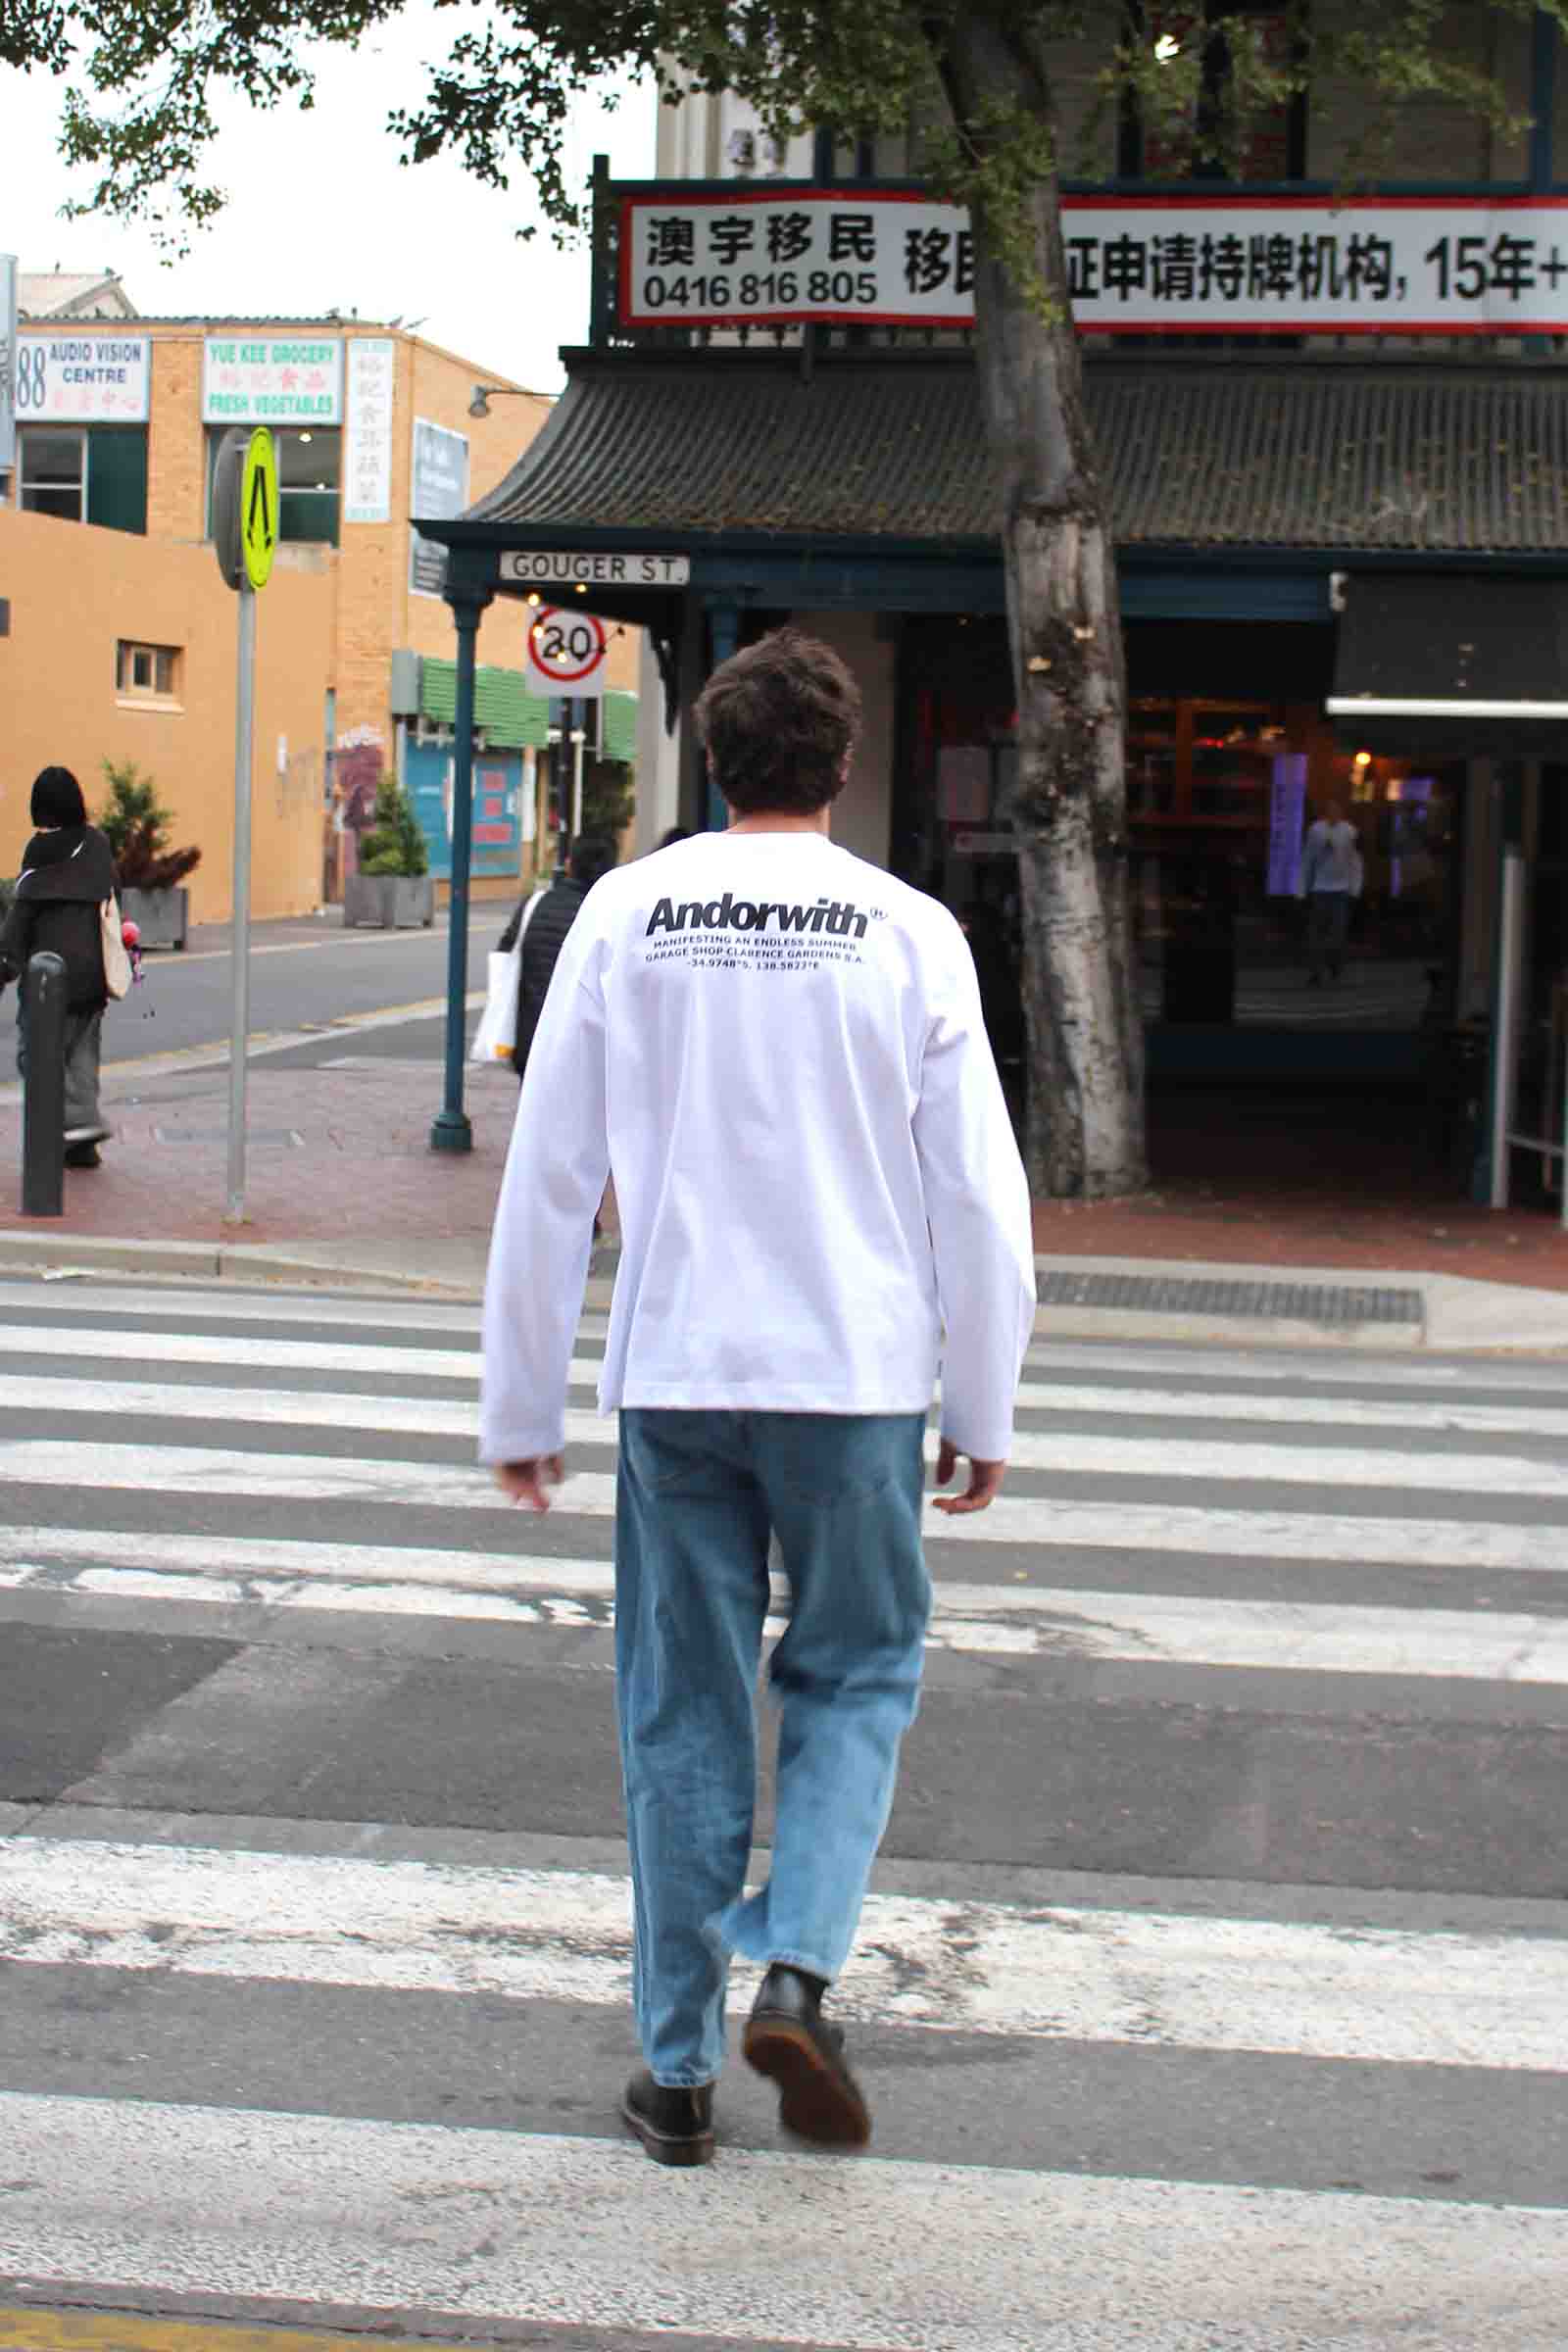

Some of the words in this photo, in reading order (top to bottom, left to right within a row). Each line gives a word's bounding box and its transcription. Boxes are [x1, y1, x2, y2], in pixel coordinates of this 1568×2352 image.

[647, 216, 876, 267] 澳宇移民
[644, 275, 730, 308] 0416
[739, 272, 799, 306] 816
[808, 270, 877, 304] 805
[50, 343, 92, 362] AUDIO
[95, 343, 141, 362] VISION
[209, 344, 236, 364] YUE
[240, 344, 268, 364] KEE
[272, 343, 334, 364] GROCERY
[17, 346, 46, 409] 88
[63, 368, 126, 384] CENTRE
[209, 393, 249, 414] FRESH
[253, 393, 333, 415] VEGETABLES
[513, 555, 627, 581] GOUGER
[642, 558, 684, 582] ST.
[541, 626, 591, 662] 20
[654, 935, 731, 949] MANIFESTING
[735, 937, 751, 946] AN
[754, 938, 805, 948] ENDLESS
[808, 939, 857, 951] SUMMER
[646, 948, 689, 962] GARAGE
[787, 949, 842, 960] GARDENS
